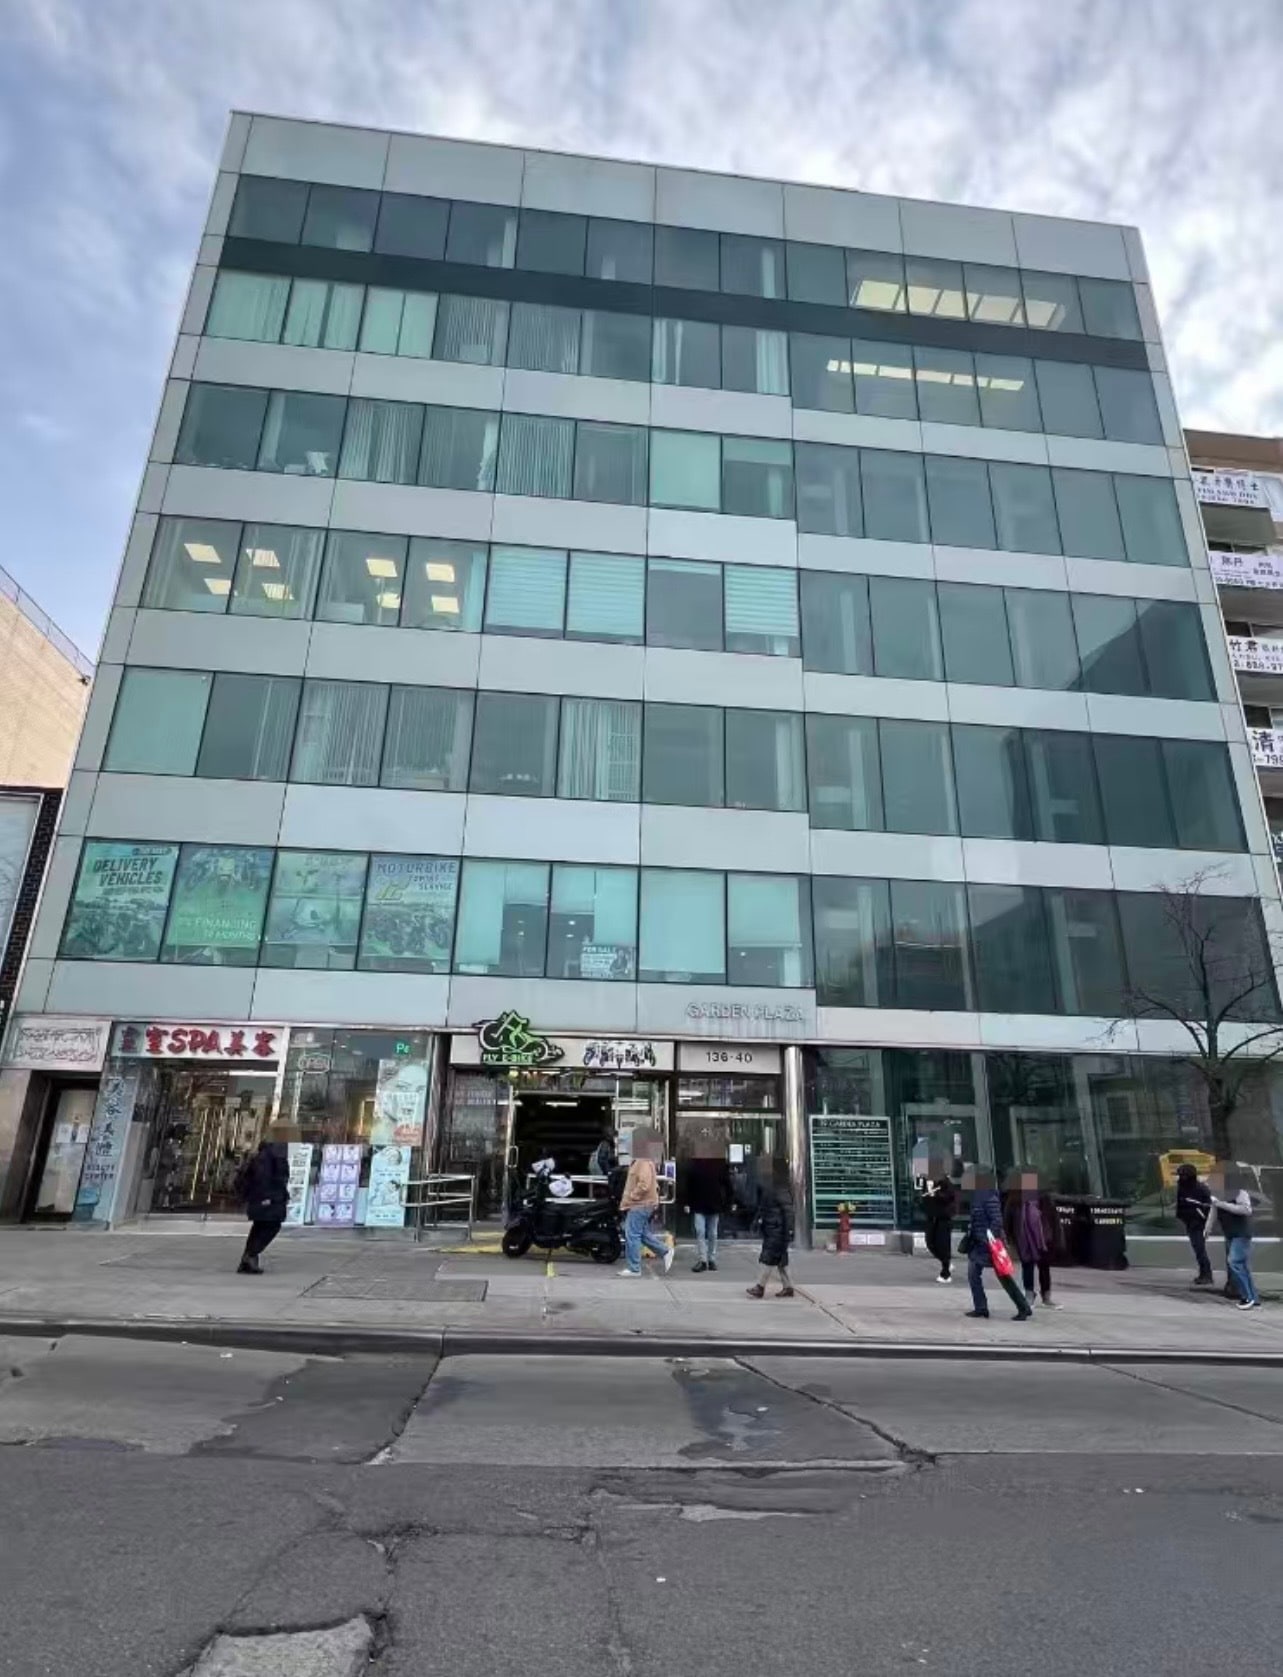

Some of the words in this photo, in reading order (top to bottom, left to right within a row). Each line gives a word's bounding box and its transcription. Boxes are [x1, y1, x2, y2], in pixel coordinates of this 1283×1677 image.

[92, 857, 159, 873] DELIVERY
[99, 871, 163, 887] VEHICLES
[687, 1002, 750, 1020] GARDEN
[482, 1053, 499, 1062] FLY
[502, 1053, 535, 1063] E-BIKE
[706, 1051, 753, 1063] 136-40
